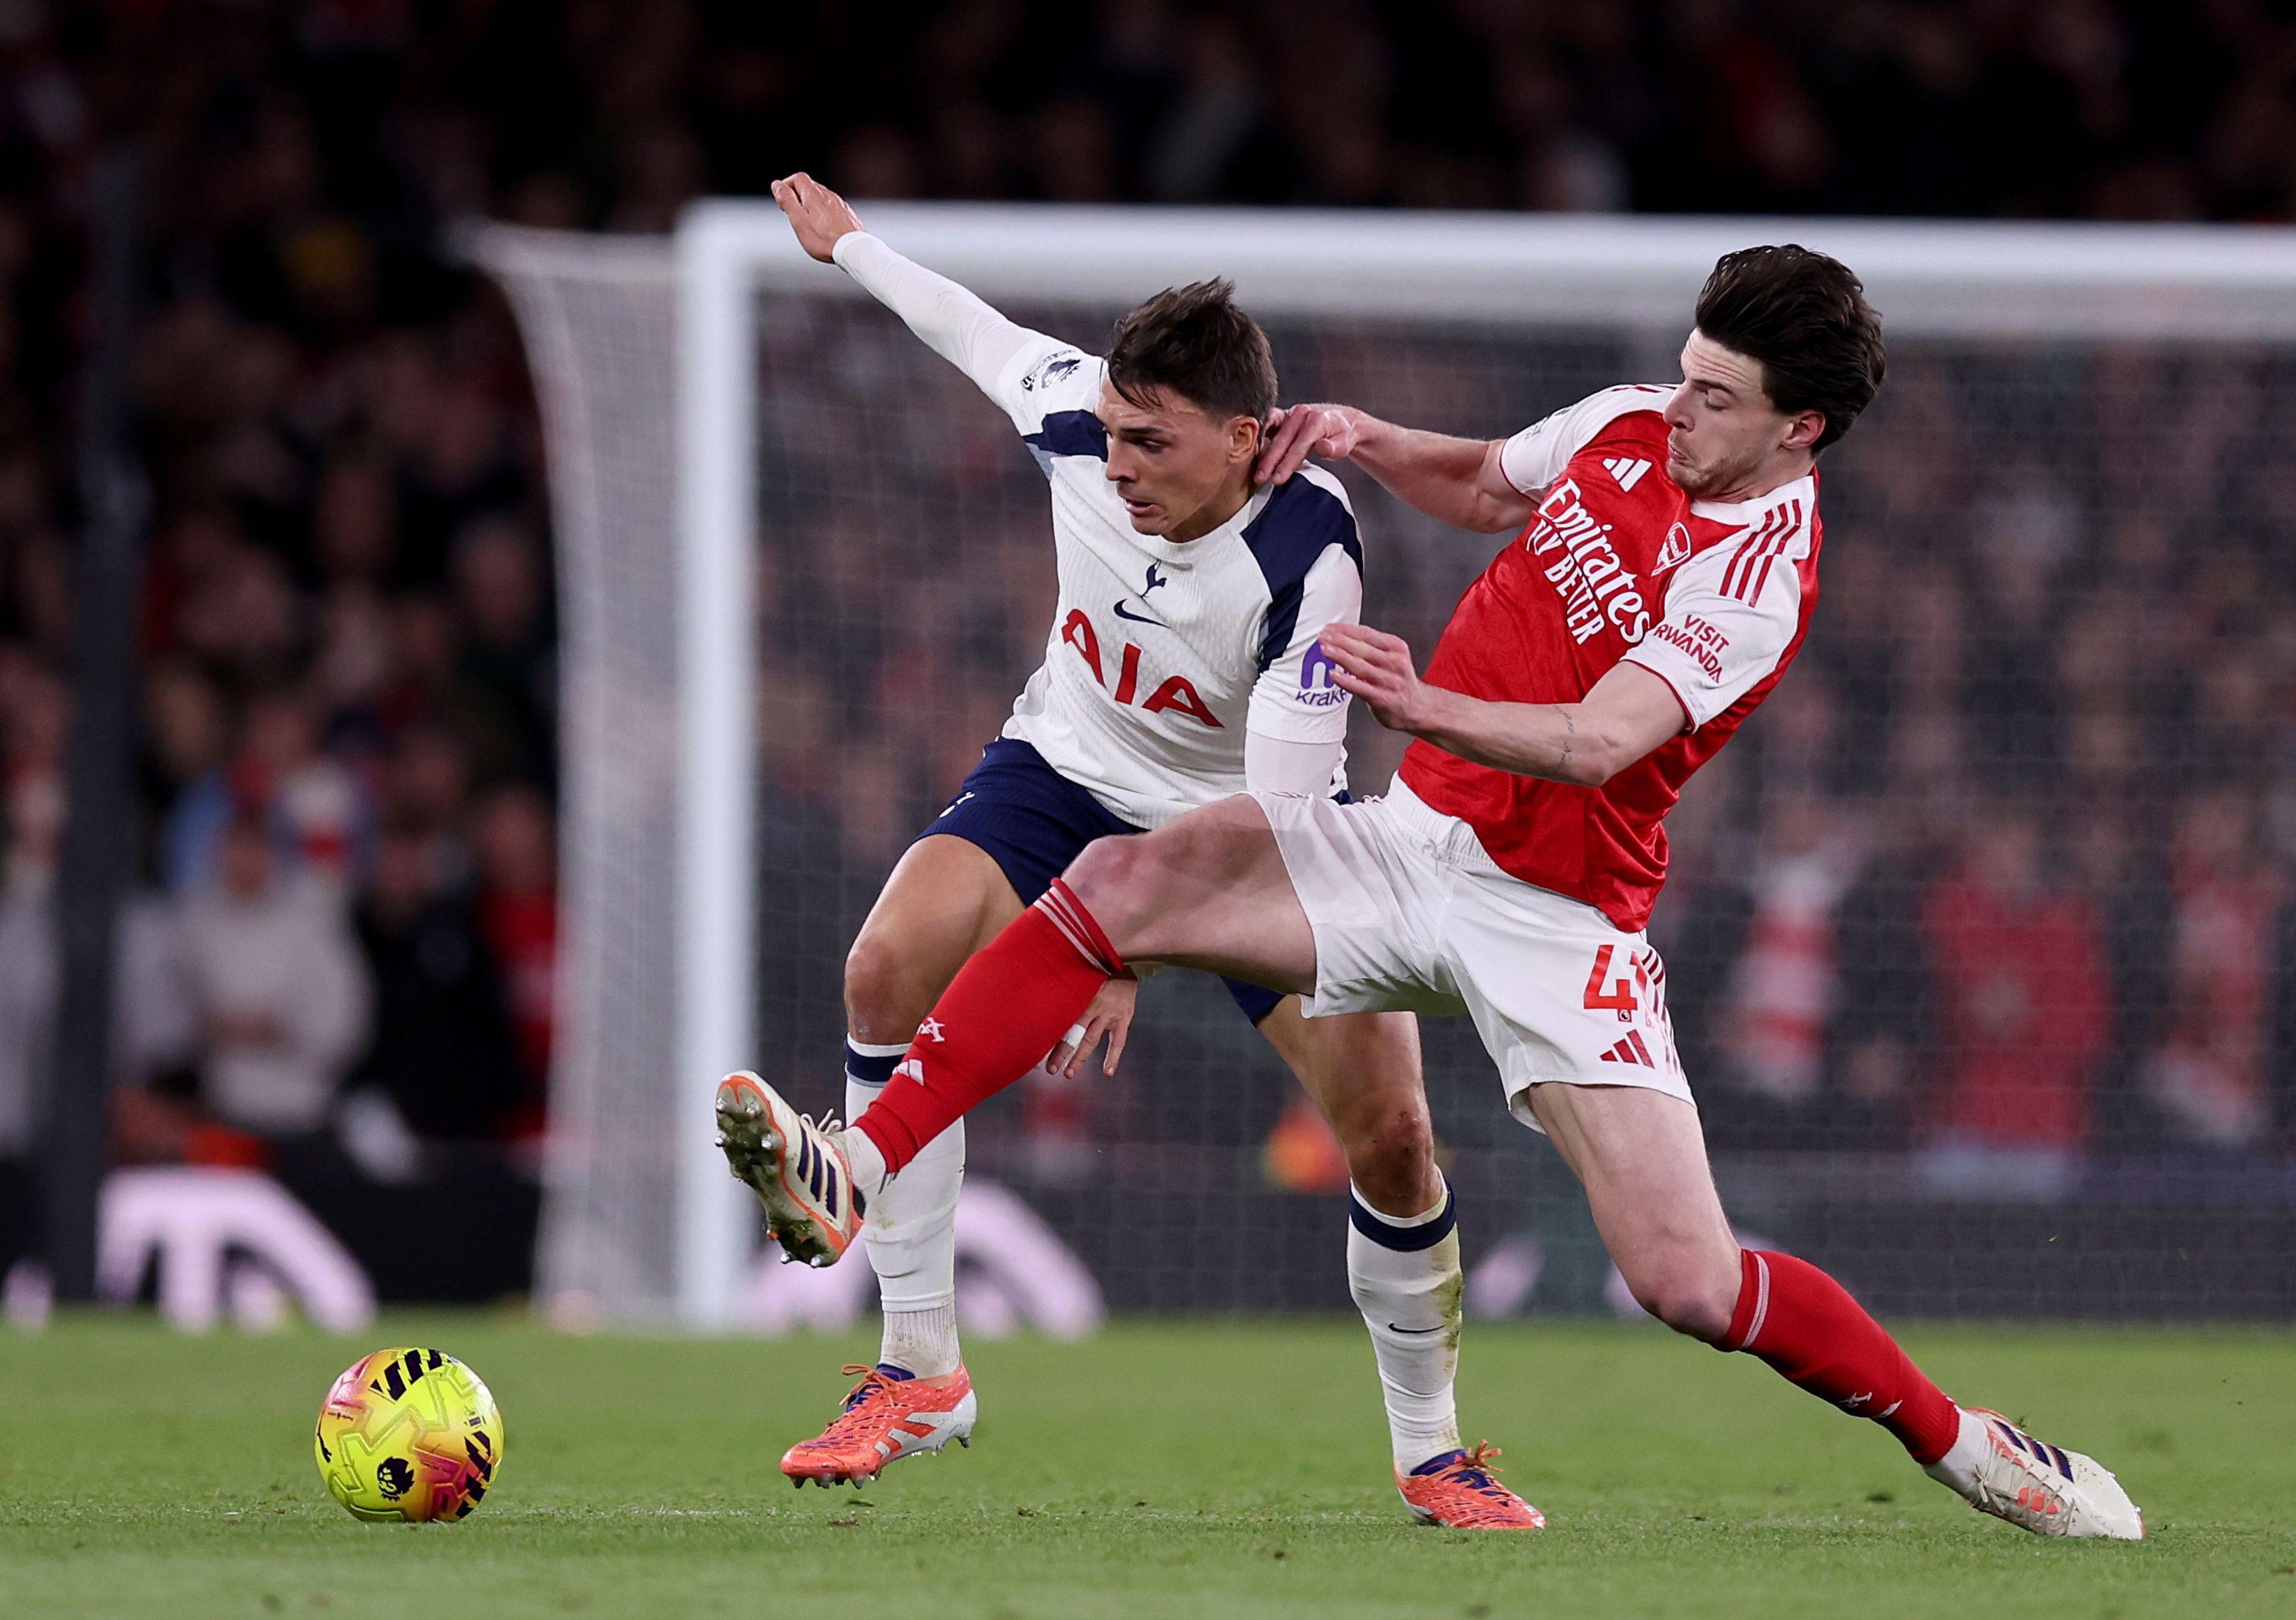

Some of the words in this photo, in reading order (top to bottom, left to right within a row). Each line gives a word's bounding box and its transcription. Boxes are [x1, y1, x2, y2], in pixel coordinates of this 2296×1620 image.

[1538, 477, 1651, 644] Emirates
[1543, 553, 1605, 645] BETTER
[1061, 609, 1225, 728] AIA
[1653, 623, 1724, 684] RWANDA
[1684, 614, 1730, 654] VISIT
[1583, 944, 1655, 1028] 41
